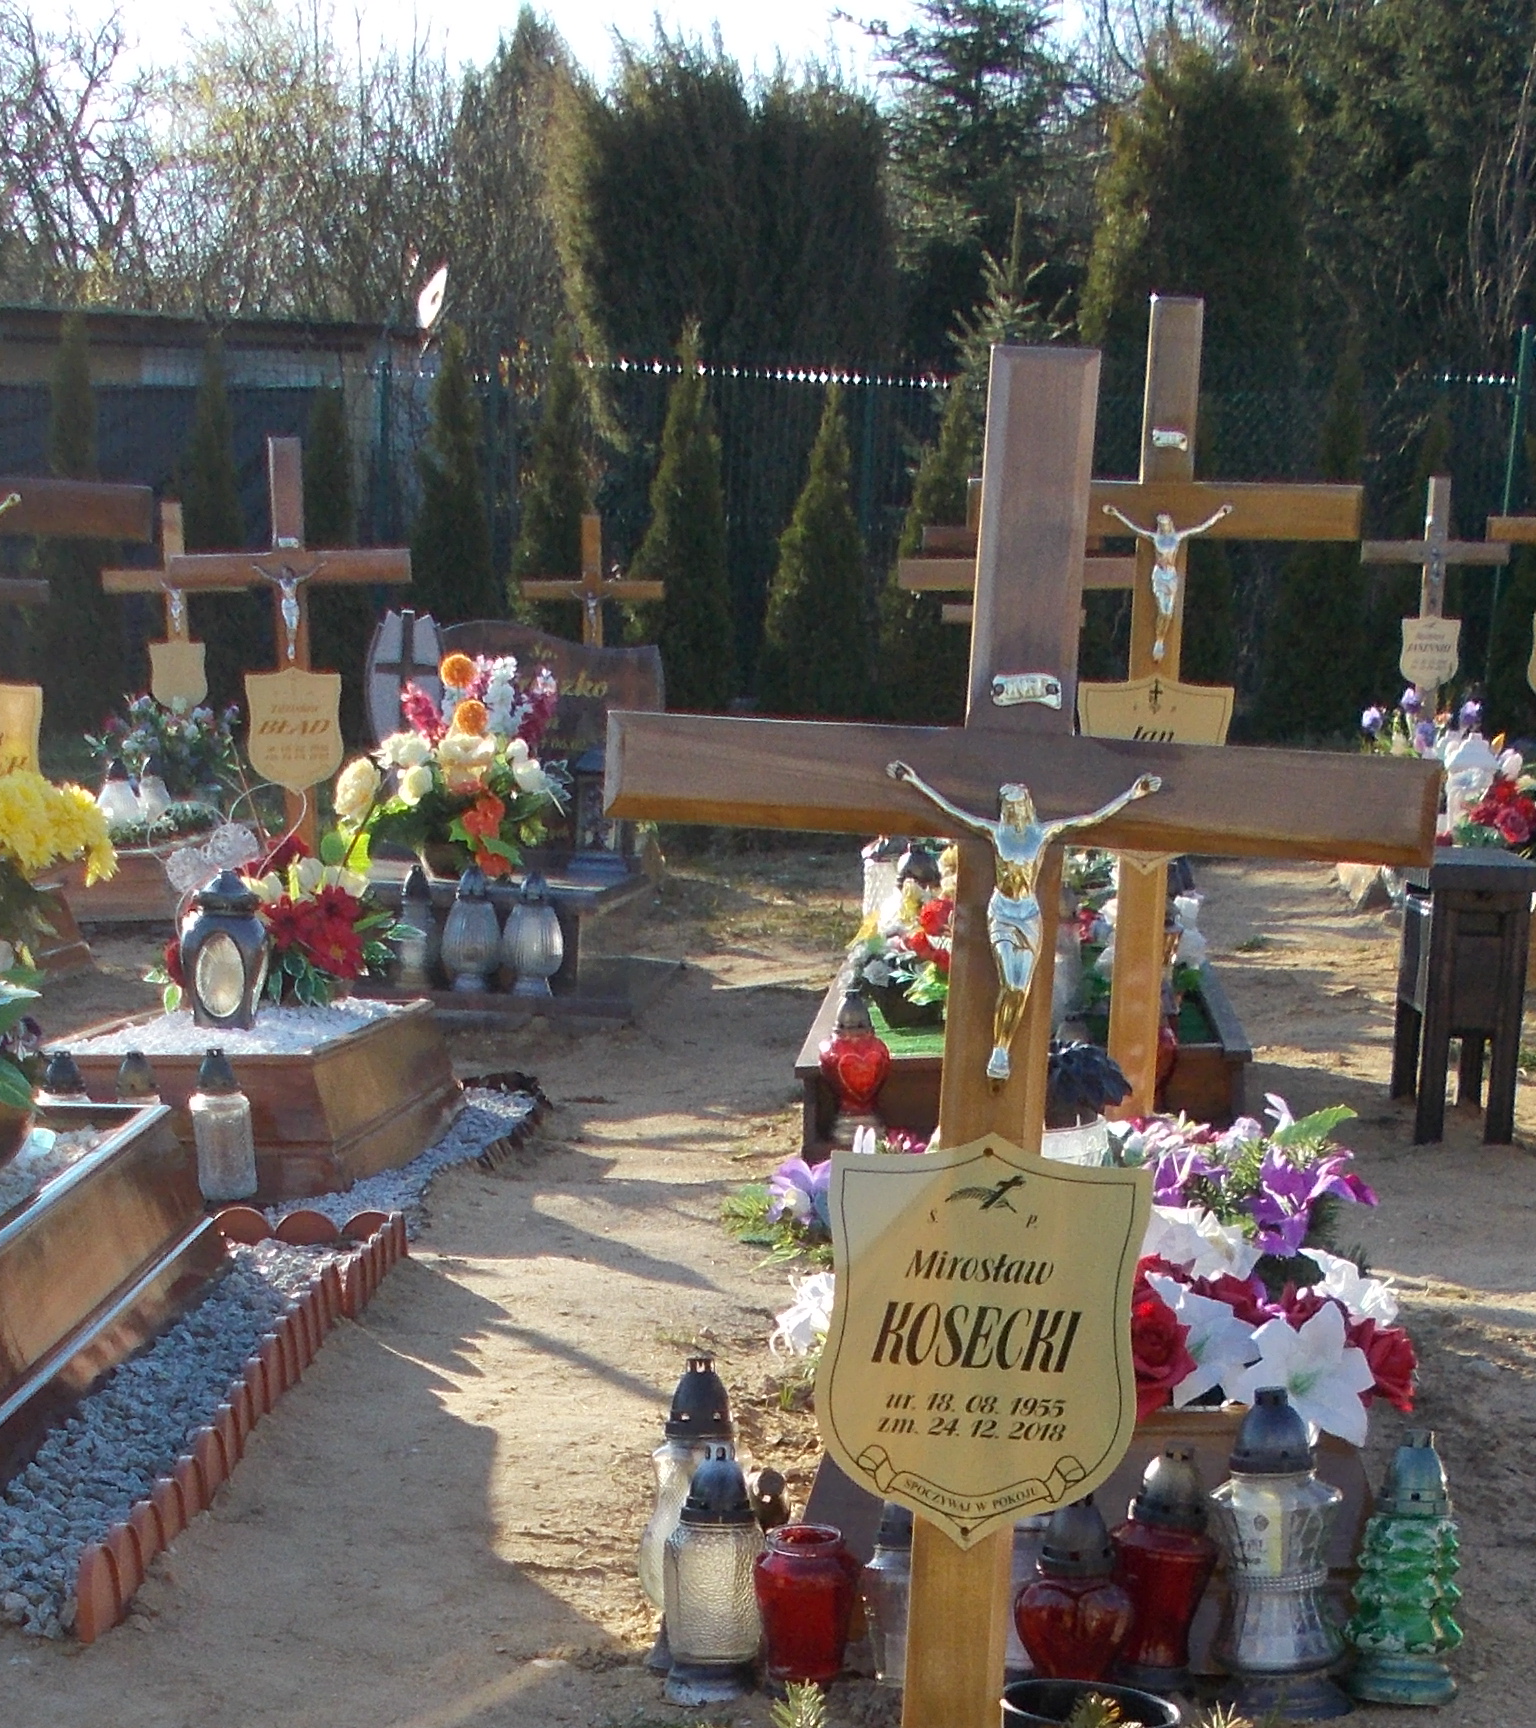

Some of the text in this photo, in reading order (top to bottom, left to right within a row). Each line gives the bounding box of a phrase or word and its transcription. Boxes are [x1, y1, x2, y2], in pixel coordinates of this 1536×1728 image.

[905, 1247, 1055, 1286] Mirosław
[870, 1300, 1083, 1374] KOSECKI
[885, 1393, 1067, 1418] ur. 18. 08. 1955
[877, 1417, 1067, 1442] zm. 24. 12. 2018
[903, 1478, 1040, 1513] SPOCZYWAJ W POKOJU
